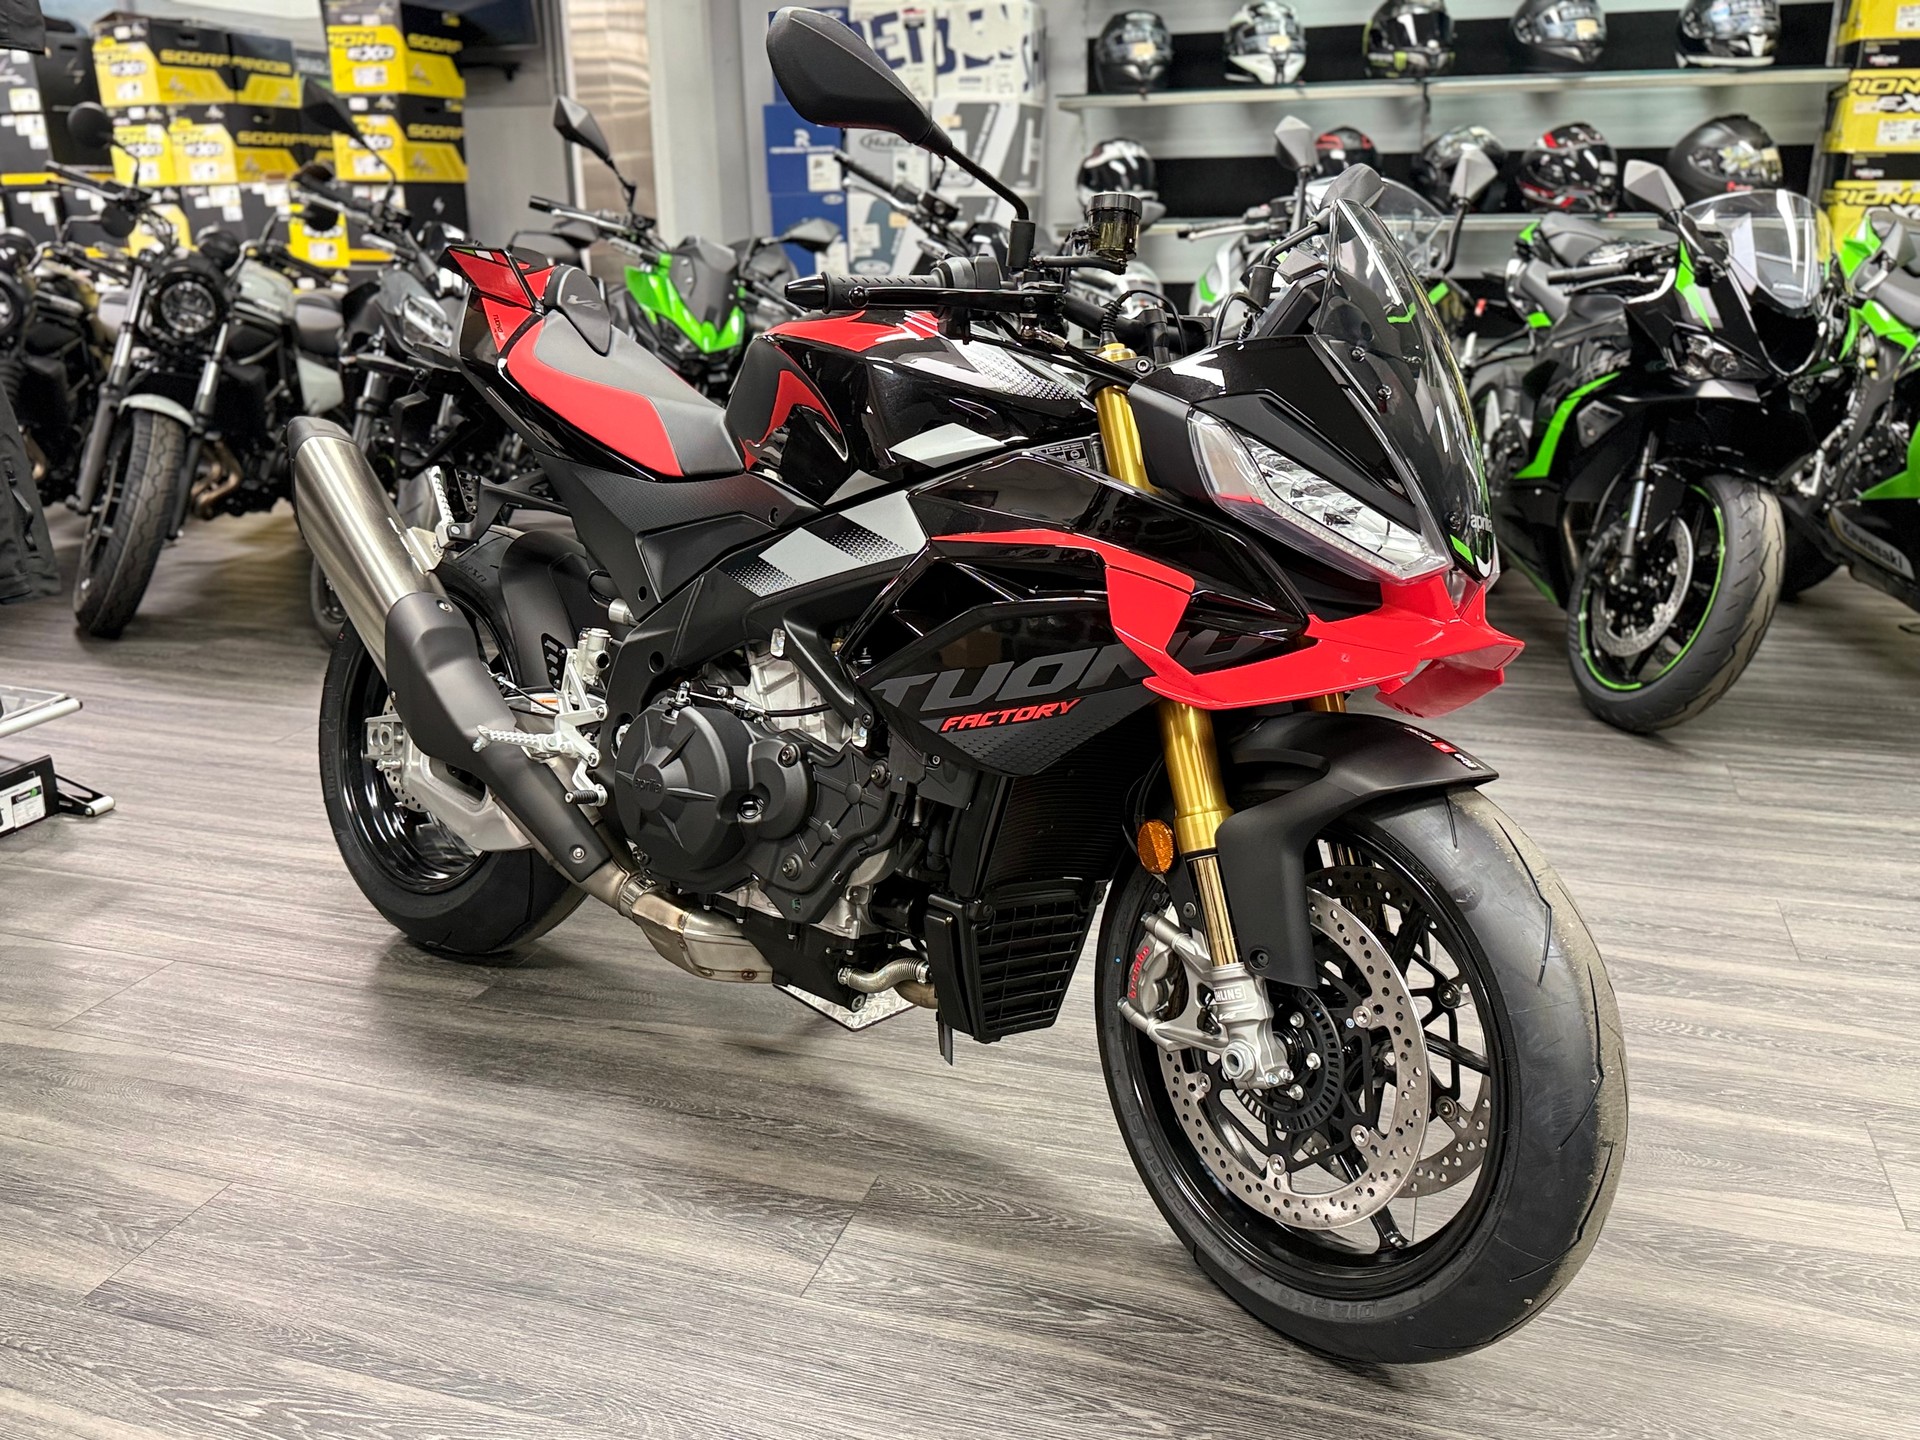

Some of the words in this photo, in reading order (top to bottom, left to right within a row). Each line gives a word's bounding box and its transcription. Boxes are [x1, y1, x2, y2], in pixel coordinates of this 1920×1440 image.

[1841, 520, 1904, 570] Kawasaki
[940, 699, 1081, 733] FACTORY
[1128, 945, 1150, 999] brembo
